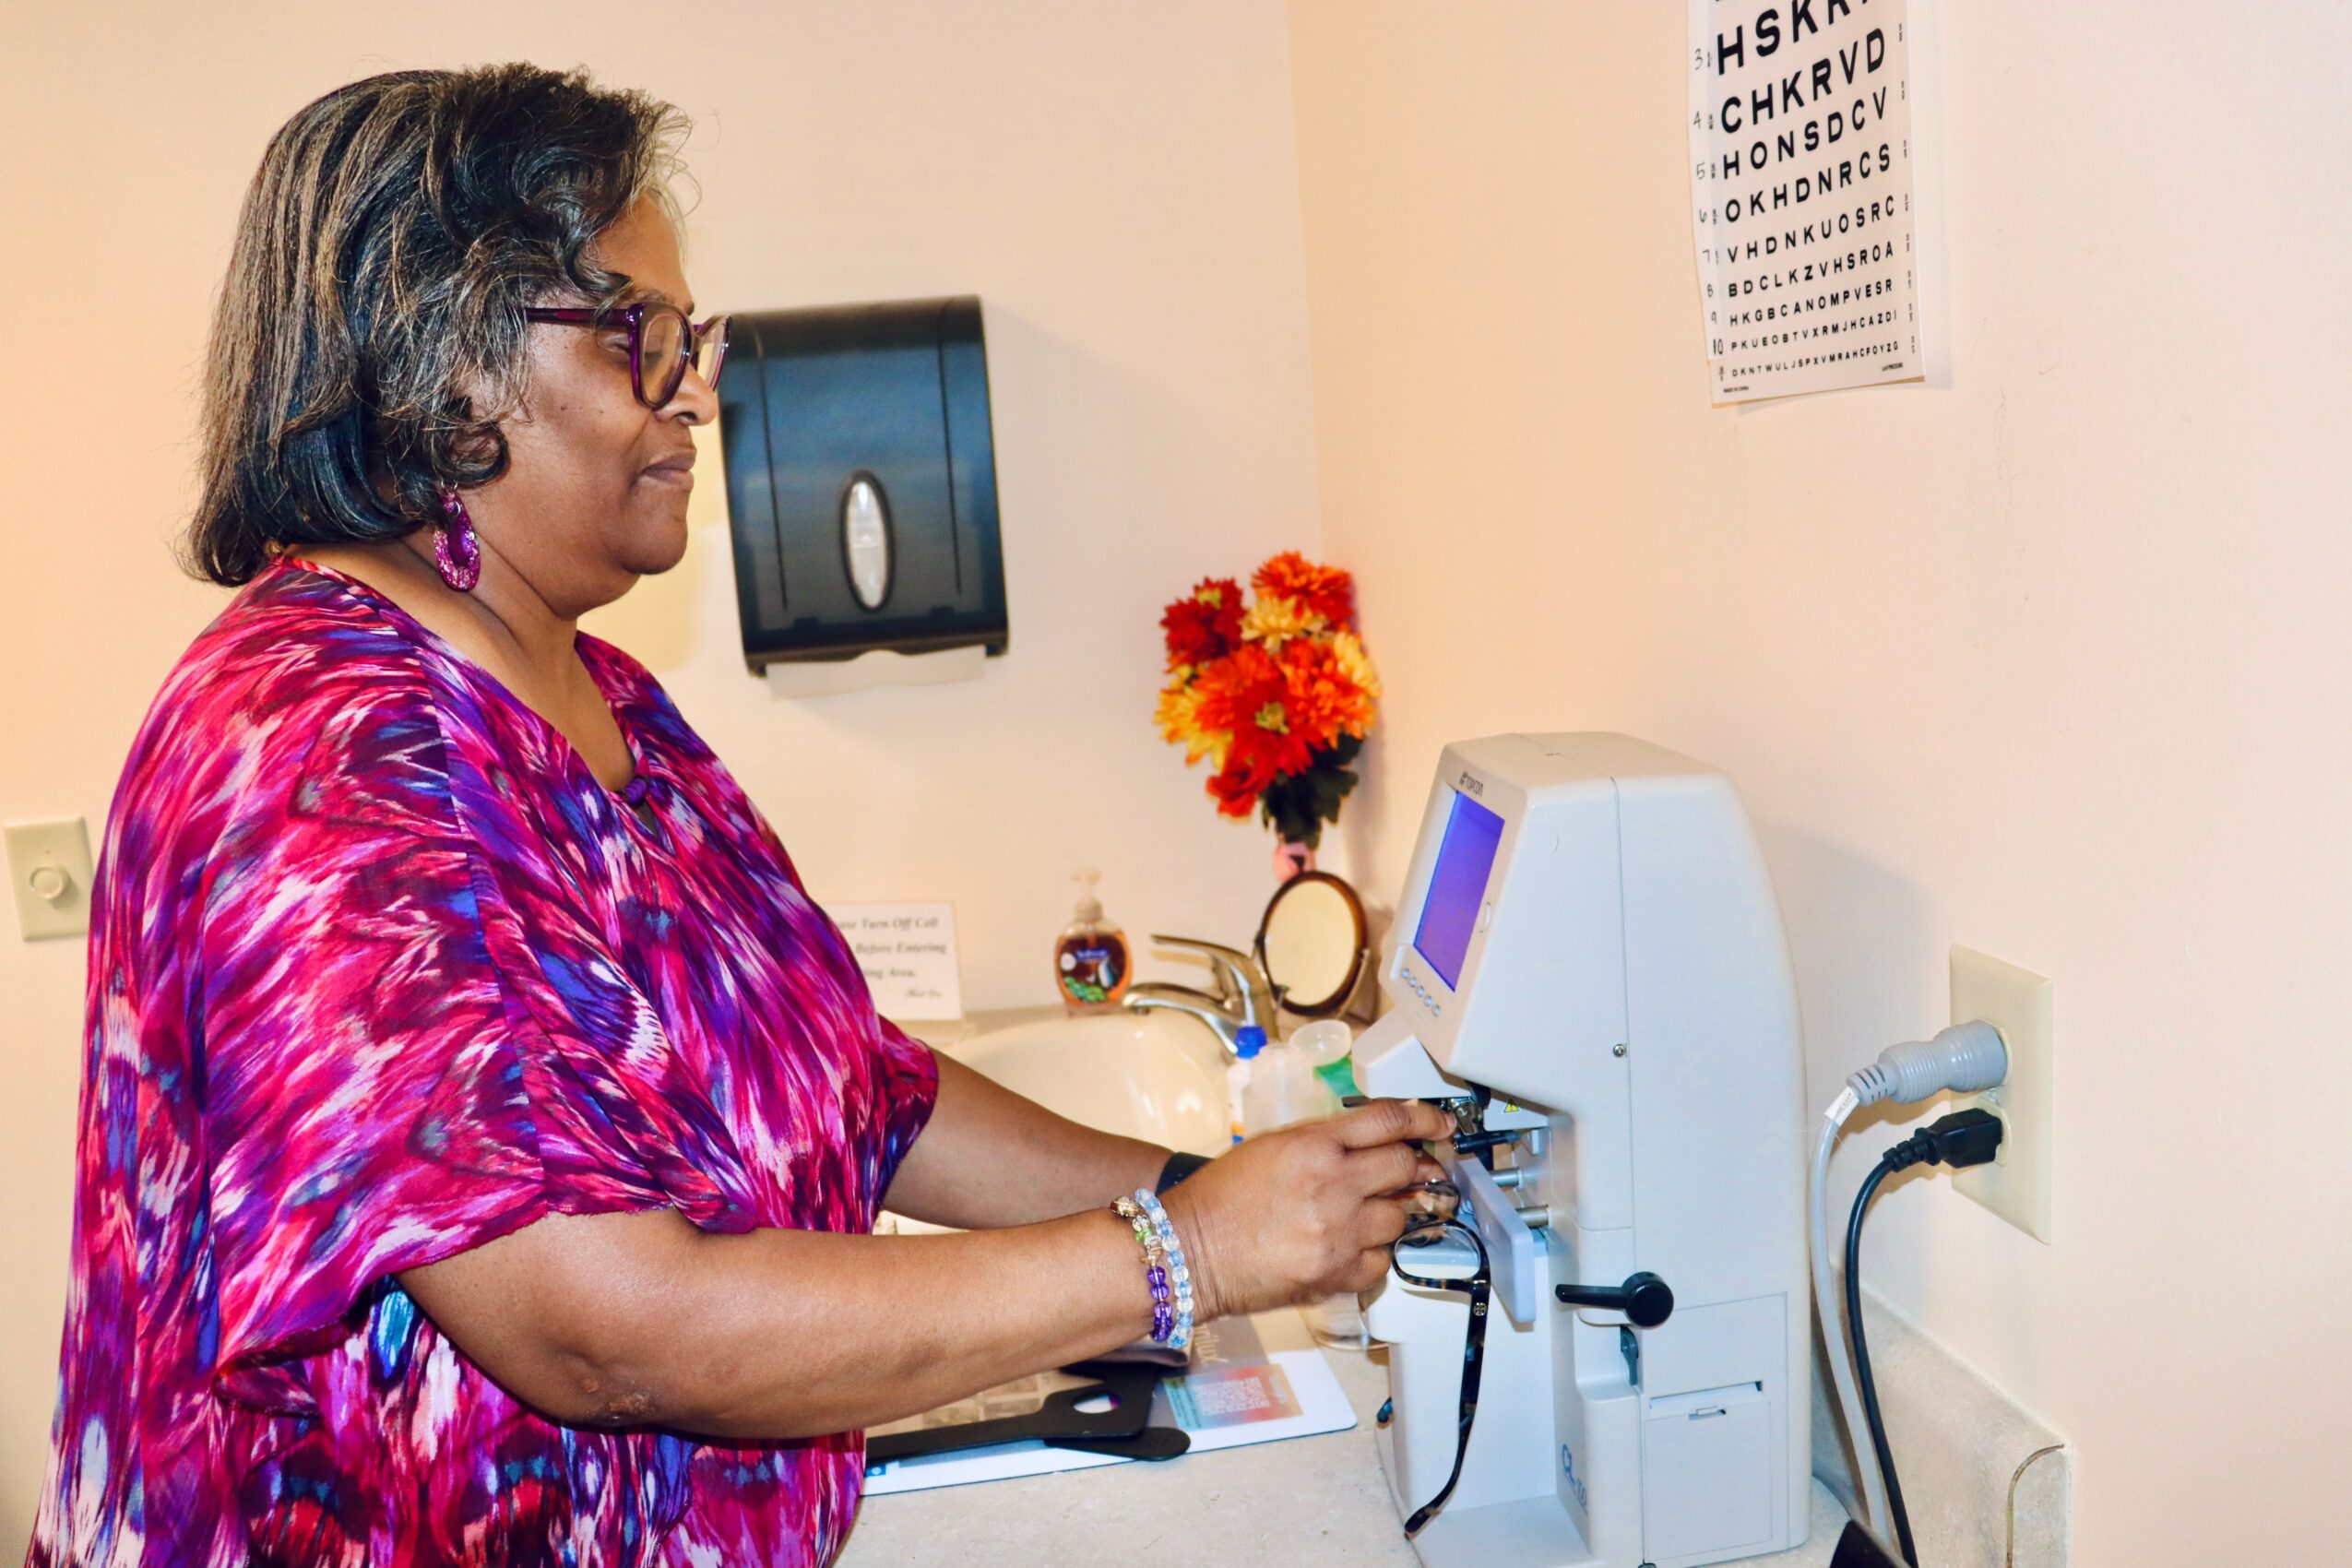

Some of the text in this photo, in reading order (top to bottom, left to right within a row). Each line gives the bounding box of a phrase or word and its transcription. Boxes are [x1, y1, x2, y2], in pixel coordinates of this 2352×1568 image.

[861, 919, 888, 929] Turn
[915, 917, 938, 928] Cell
[856, 943, 946, 955] Before Entering
